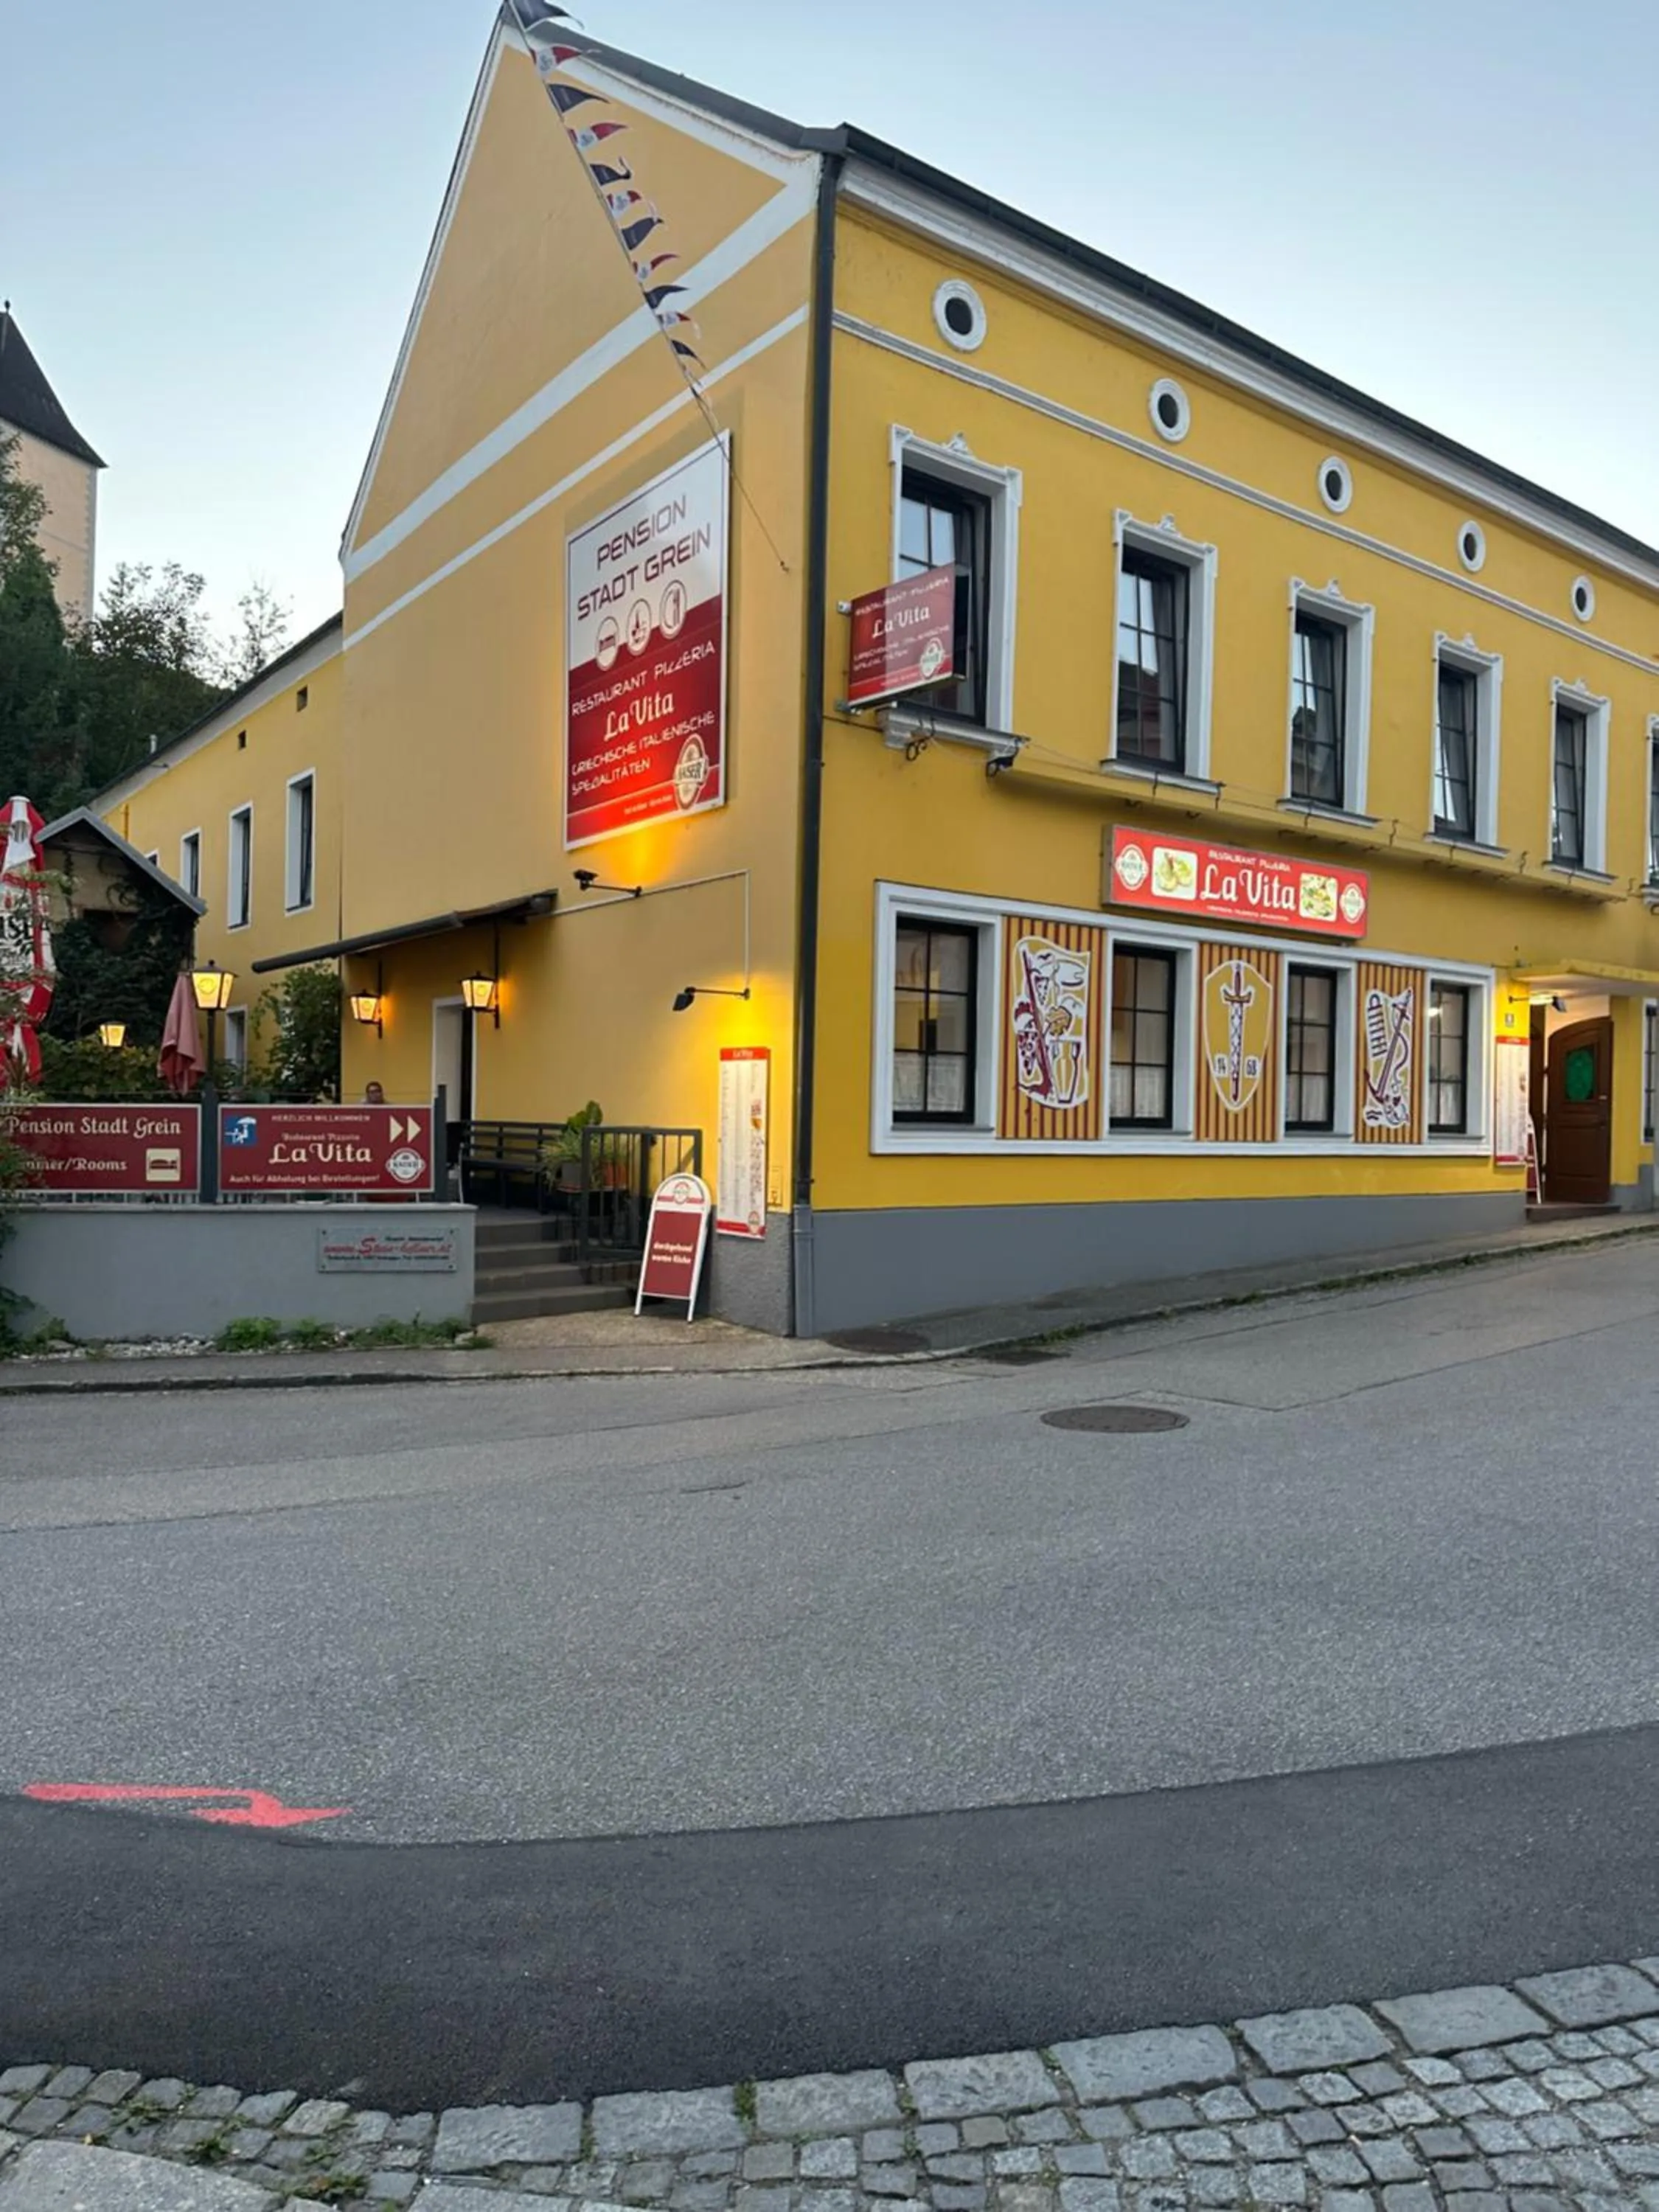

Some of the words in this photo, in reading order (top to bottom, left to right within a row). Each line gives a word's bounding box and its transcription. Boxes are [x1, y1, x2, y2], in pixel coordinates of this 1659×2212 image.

[597, 493, 686, 571] PENSION
[578, 565, 639, 620] STADT
[644, 522, 710, 582] GREIN
[872, 619, 894, 639] La
[896, 606, 931, 627] Vita
[571, 670, 647, 716] RESTAURANT
[653, 640, 715, 680] PIZZERIA
[604, 711, 630, 742] La
[630, 692, 675, 726] Vita
[571, 742, 637, 776] GRIECHISCHE
[639, 711, 714, 750] ITALIENISCHE
[1200, 863, 1237, 902] La
[1239, 869, 1295, 911] Vita
[4, 1116, 74, 1135] Pension
[80, 1116, 129, 1134] Stadt
[133, 1116, 181, 1139] Grein
[268, 1143, 307, 1164] La
[310, 1143, 372, 1164] Vita
